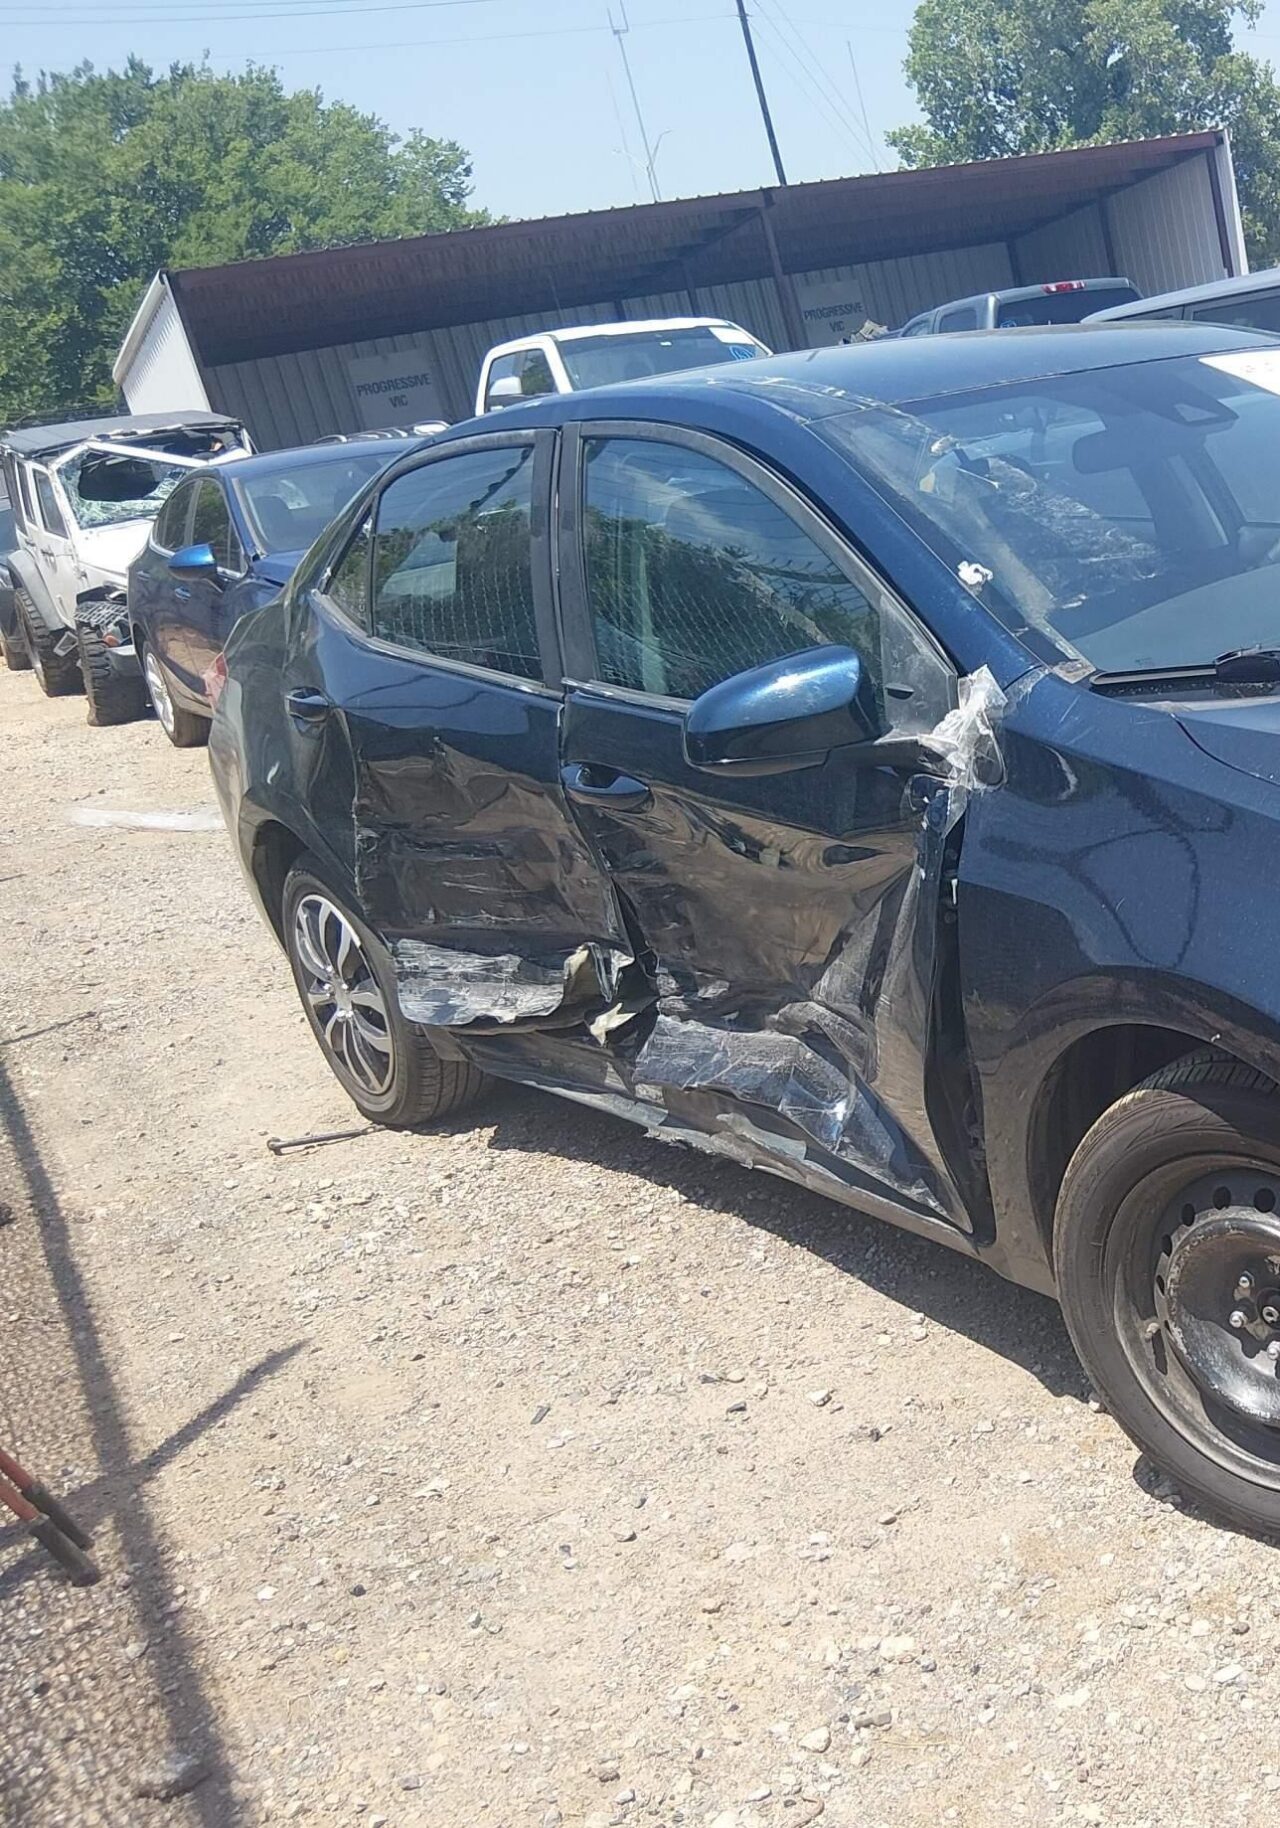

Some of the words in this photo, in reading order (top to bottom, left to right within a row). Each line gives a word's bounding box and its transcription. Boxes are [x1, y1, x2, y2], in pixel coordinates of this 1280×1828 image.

[803, 302, 863, 321] PROGRESSIVE
[829, 320, 845, 333] VIC
[356, 373, 432, 397] PROGRESSIVE
[388, 394, 409, 408] VIC
